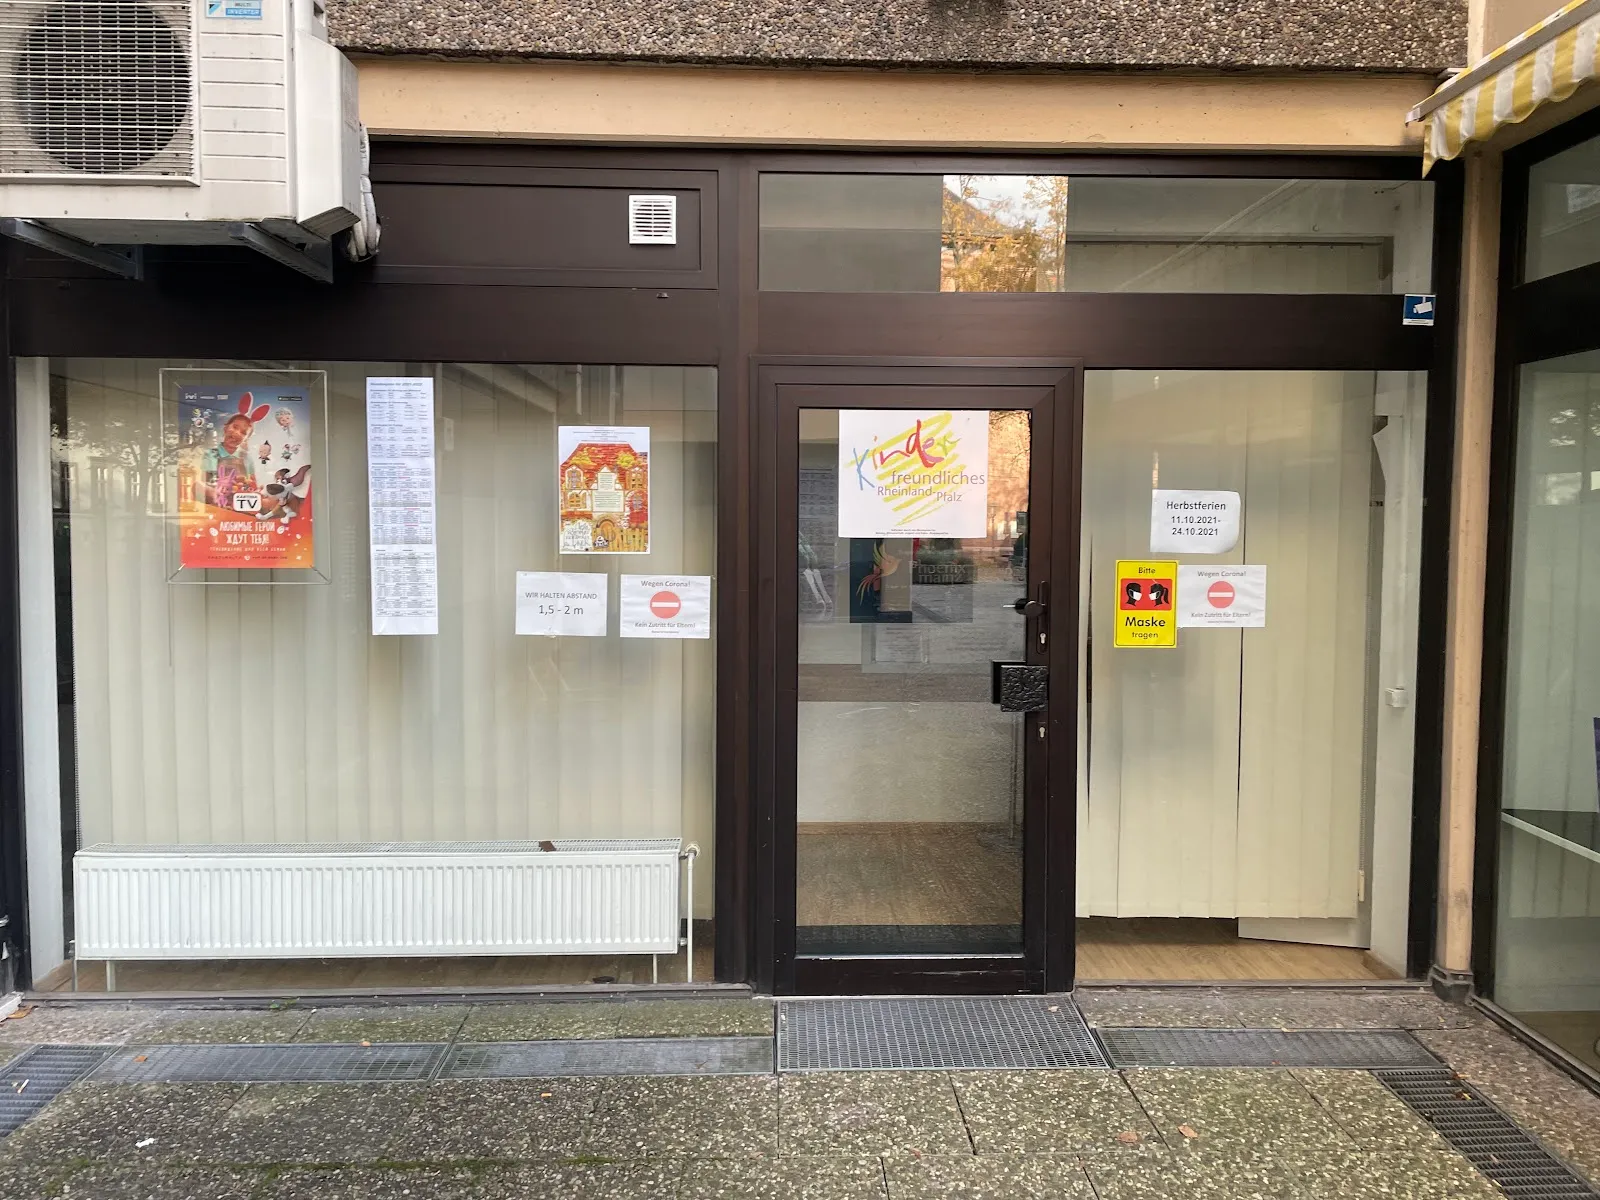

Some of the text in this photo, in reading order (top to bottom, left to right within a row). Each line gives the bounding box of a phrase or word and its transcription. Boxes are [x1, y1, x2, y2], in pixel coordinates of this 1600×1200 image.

[853, 419, 961, 490] Kinder
[891, 470, 985, 485] freundliches
[237, 500, 258, 509] TV
[1166, 501, 1226, 510] Herbstferien
[1171, 516, 1221, 524] 11.10.2021-
[220, 521, 275, 532] ЛЮБИМЫЕ ГЕРОИ
[1172, 528, 1218, 536] 24.10.2021
[226, 534, 247, 545] ЖДУТ
[538, 605, 555, 616] 1,5
[564, 605, 570, 615] 2
[573, 607, 583, 615] m
[1125, 616, 1166, 627] Maske
[1131, 631, 1158, 640] tragen
